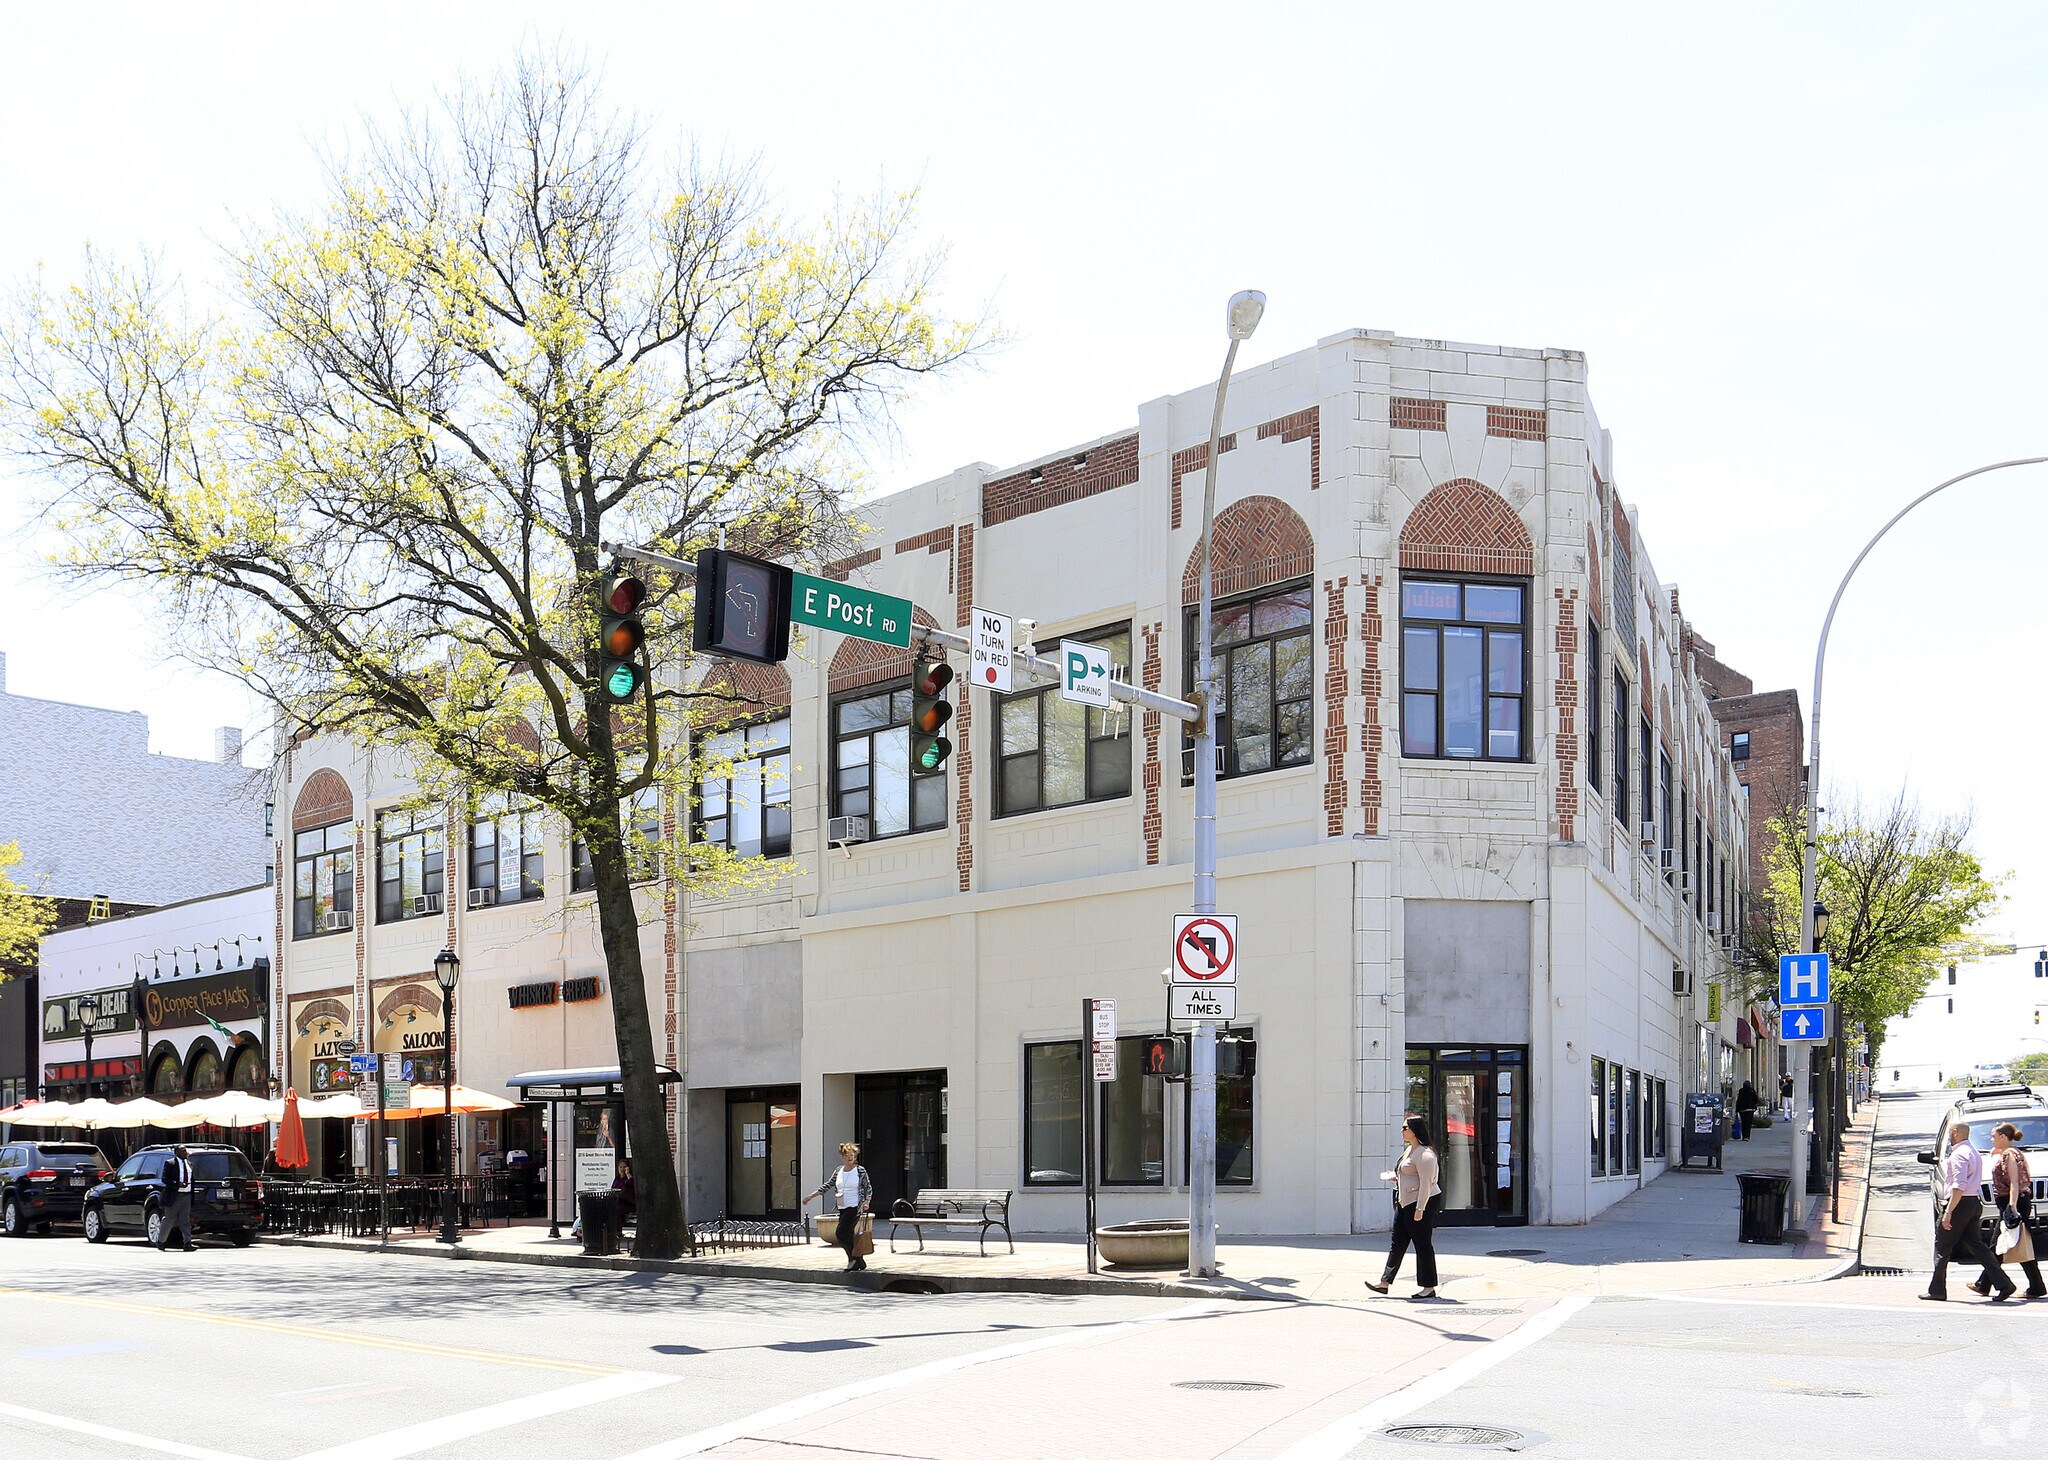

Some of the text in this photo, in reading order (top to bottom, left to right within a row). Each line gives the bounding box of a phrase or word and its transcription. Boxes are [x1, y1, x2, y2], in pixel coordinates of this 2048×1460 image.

[805, 588, 897, 634] E Post RD
[982, 615, 1002, 634] NO
[979, 633, 1005, 652] TURN
[974, 649, 1009, 669] ON RED
[1790, 960, 1818, 998] H
[508, 976, 598, 1009] WHISKEY CREEK
[1191, 990, 1216, 1002] ALL
[101, 991, 128, 1016] BEAR
[1186, 1003, 1222, 1016] TIMES
[314, 1040, 340, 1057] LAZY
[402, 1031, 446, 1050] SALOON
